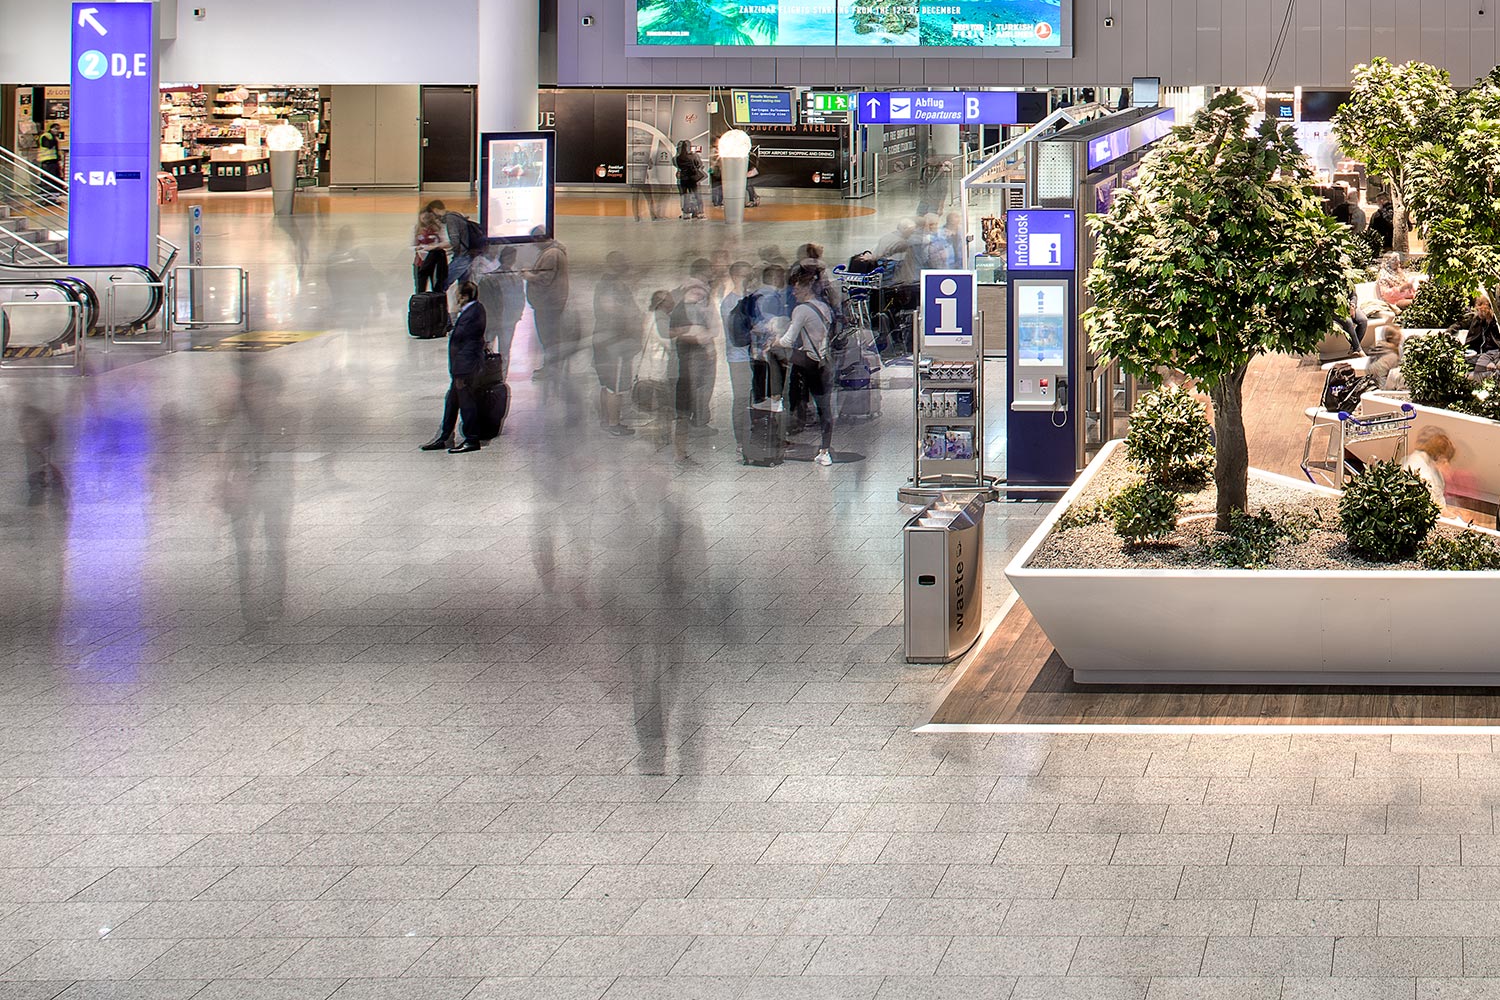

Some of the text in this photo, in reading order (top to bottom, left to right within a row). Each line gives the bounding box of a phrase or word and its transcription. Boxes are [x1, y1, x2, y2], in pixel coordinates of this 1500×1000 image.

[740, 6, 777, 14] ZANZIBAR
[922, 6, 961, 15] DECEMBER
[84, 53, 147, 80] 2 D,E
[915, 97, 981, 119] Abflug B
[915, 110, 962, 120] Departures
[803, 124, 837, 133] AVENUE
[105, 171, 117, 186] A
[1015, 214, 1029, 267] Infokiosk
[955, 561, 964, 632] waste
